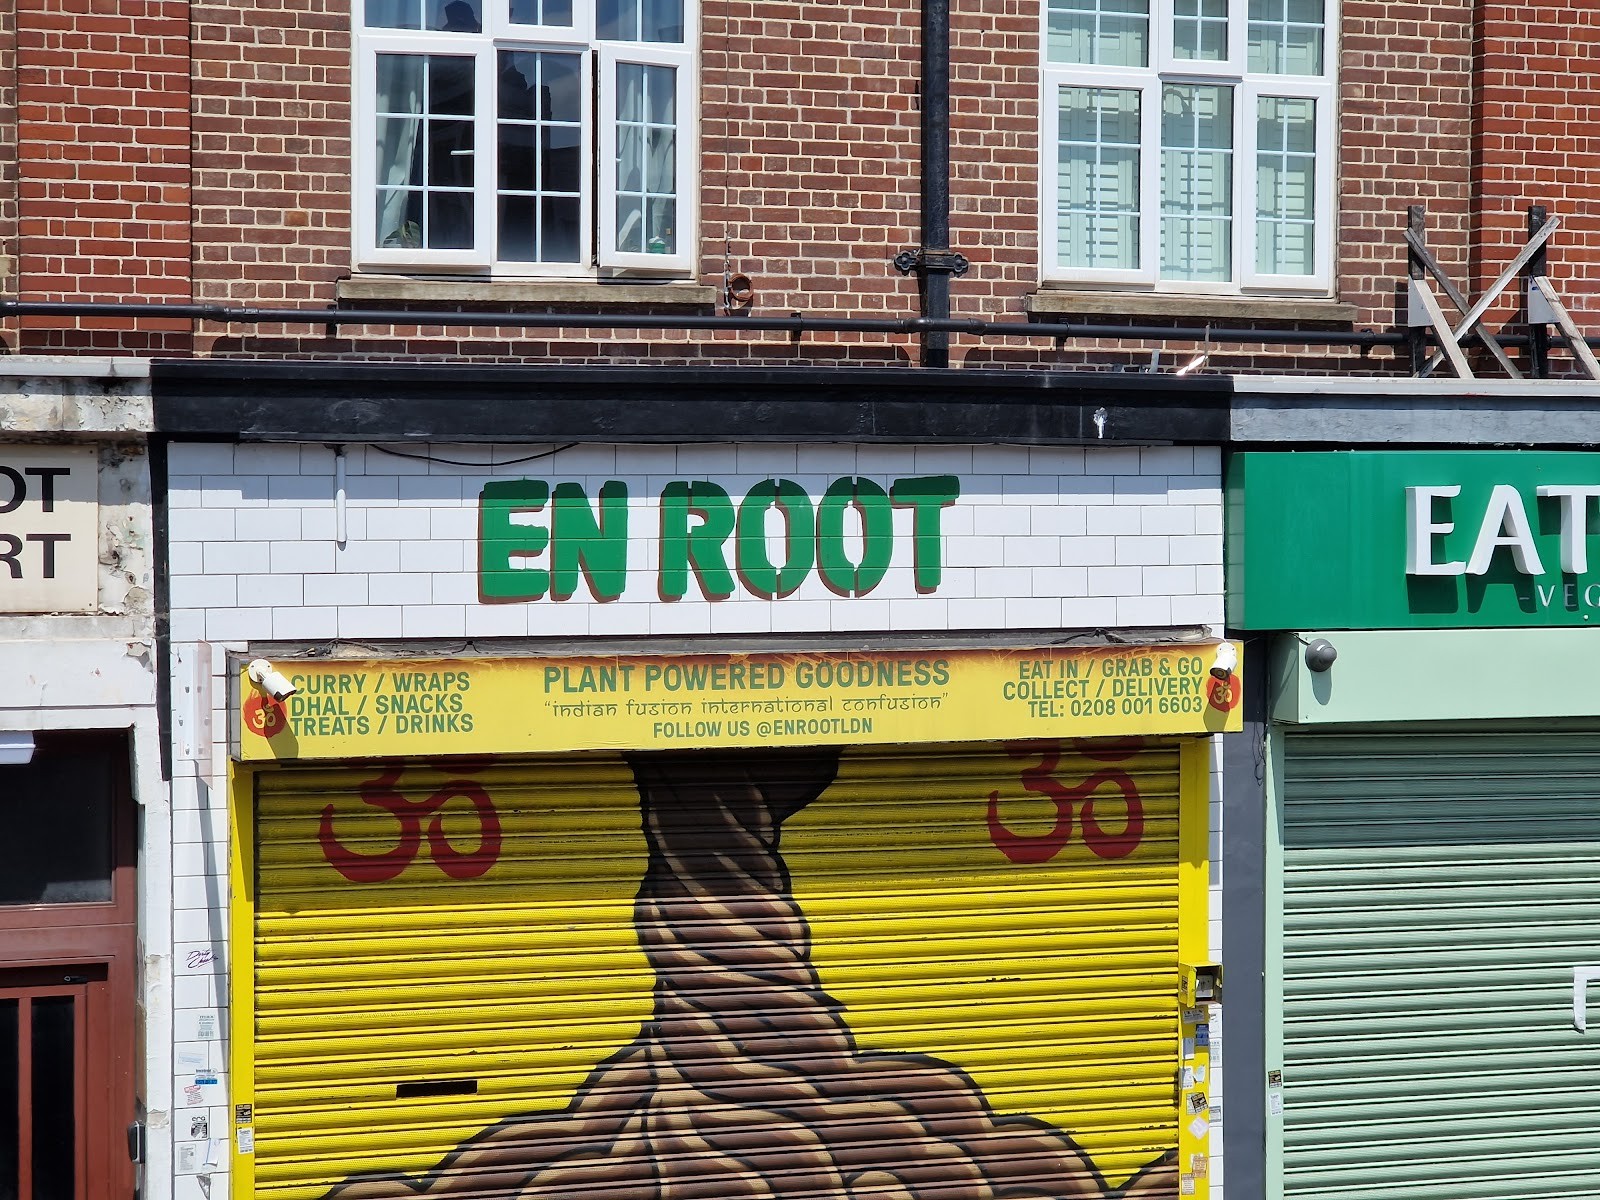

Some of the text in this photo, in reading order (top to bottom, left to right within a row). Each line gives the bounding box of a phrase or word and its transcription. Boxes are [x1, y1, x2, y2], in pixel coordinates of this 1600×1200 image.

[478, 475, 960, 604] EN ROOT
[1405, 484, 1600, 575] EAT
[544, 659, 950, 693] PLANT POWERED GOODNESS
[1019, 656, 1203, 680] EAT IN / GRAB & GO
[291, 671, 470, 695] CURRY / WRAPS
[1003, 677, 1203, 700] COLLECT / DELIVERY
[291, 693, 463, 717] DHAL / SNACKS
[626, 698, 692, 716] fusion
[701, 696, 833, 715] international
[1028, 696, 1203, 718] TEL: 0208 001 6603
[290, 713, 474, 737] TREATS / DRINKS
[653, 717, 873, 738] FOLLOW US @ENROOTLDN
